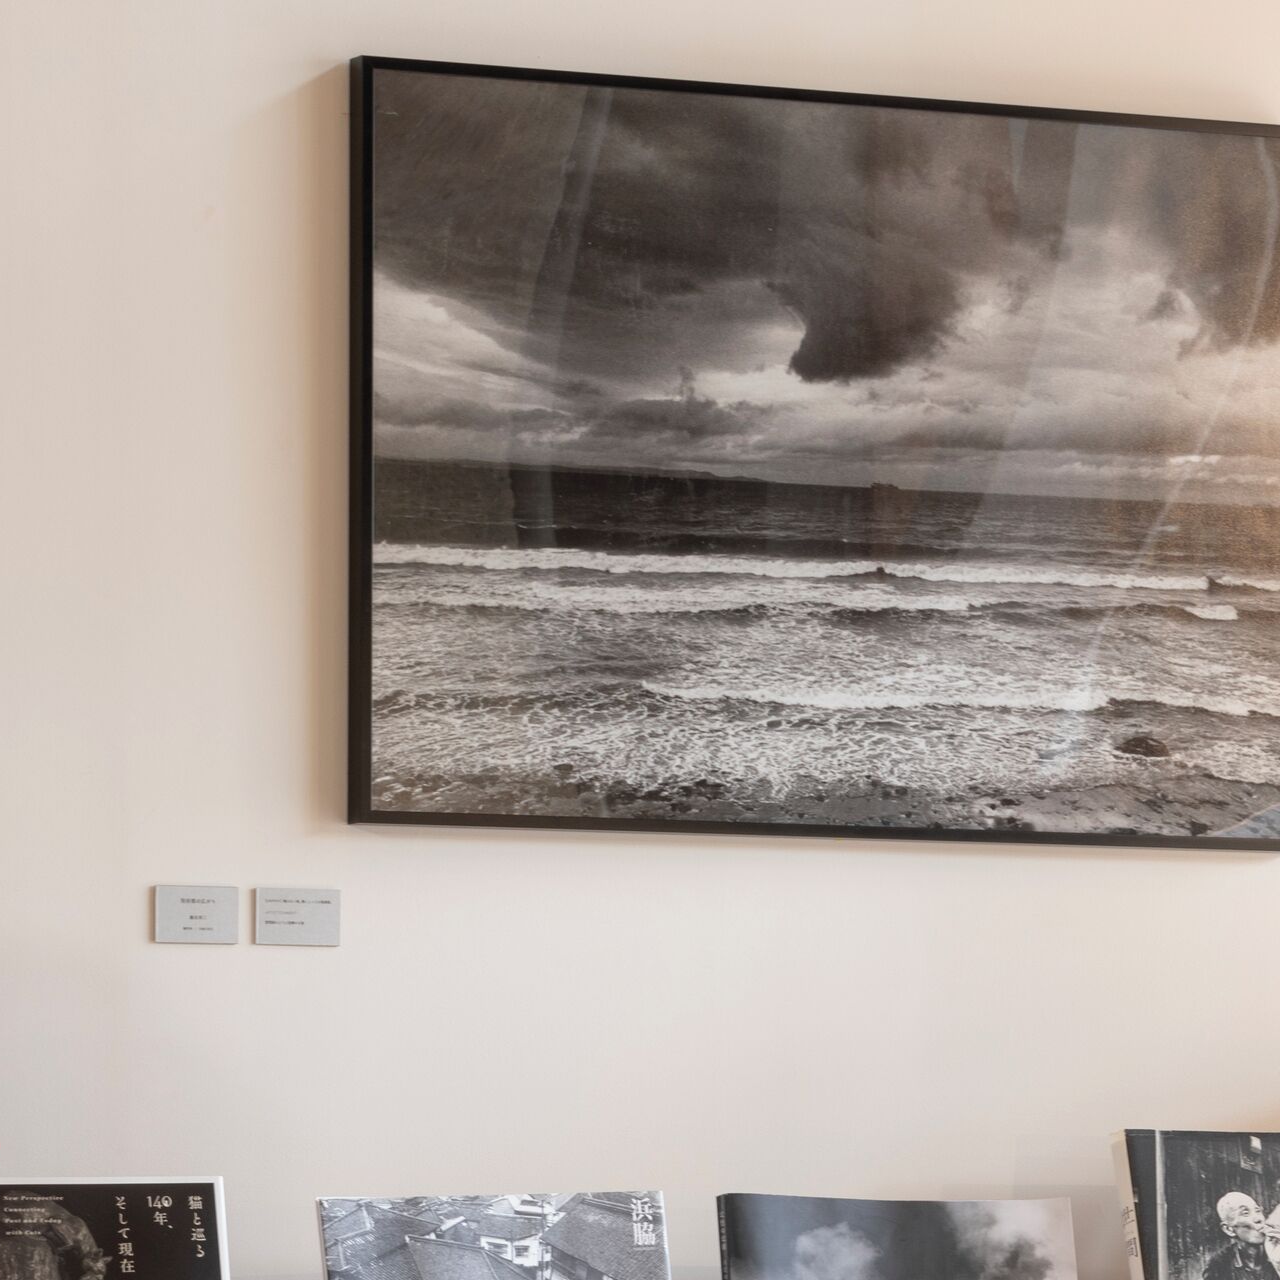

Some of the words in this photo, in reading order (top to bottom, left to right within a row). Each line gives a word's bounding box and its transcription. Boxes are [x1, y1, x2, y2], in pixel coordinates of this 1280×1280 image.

[115, 1196, 136, 1274] そして現在
[187, 1195, 207, 1258] 猫と巡る
